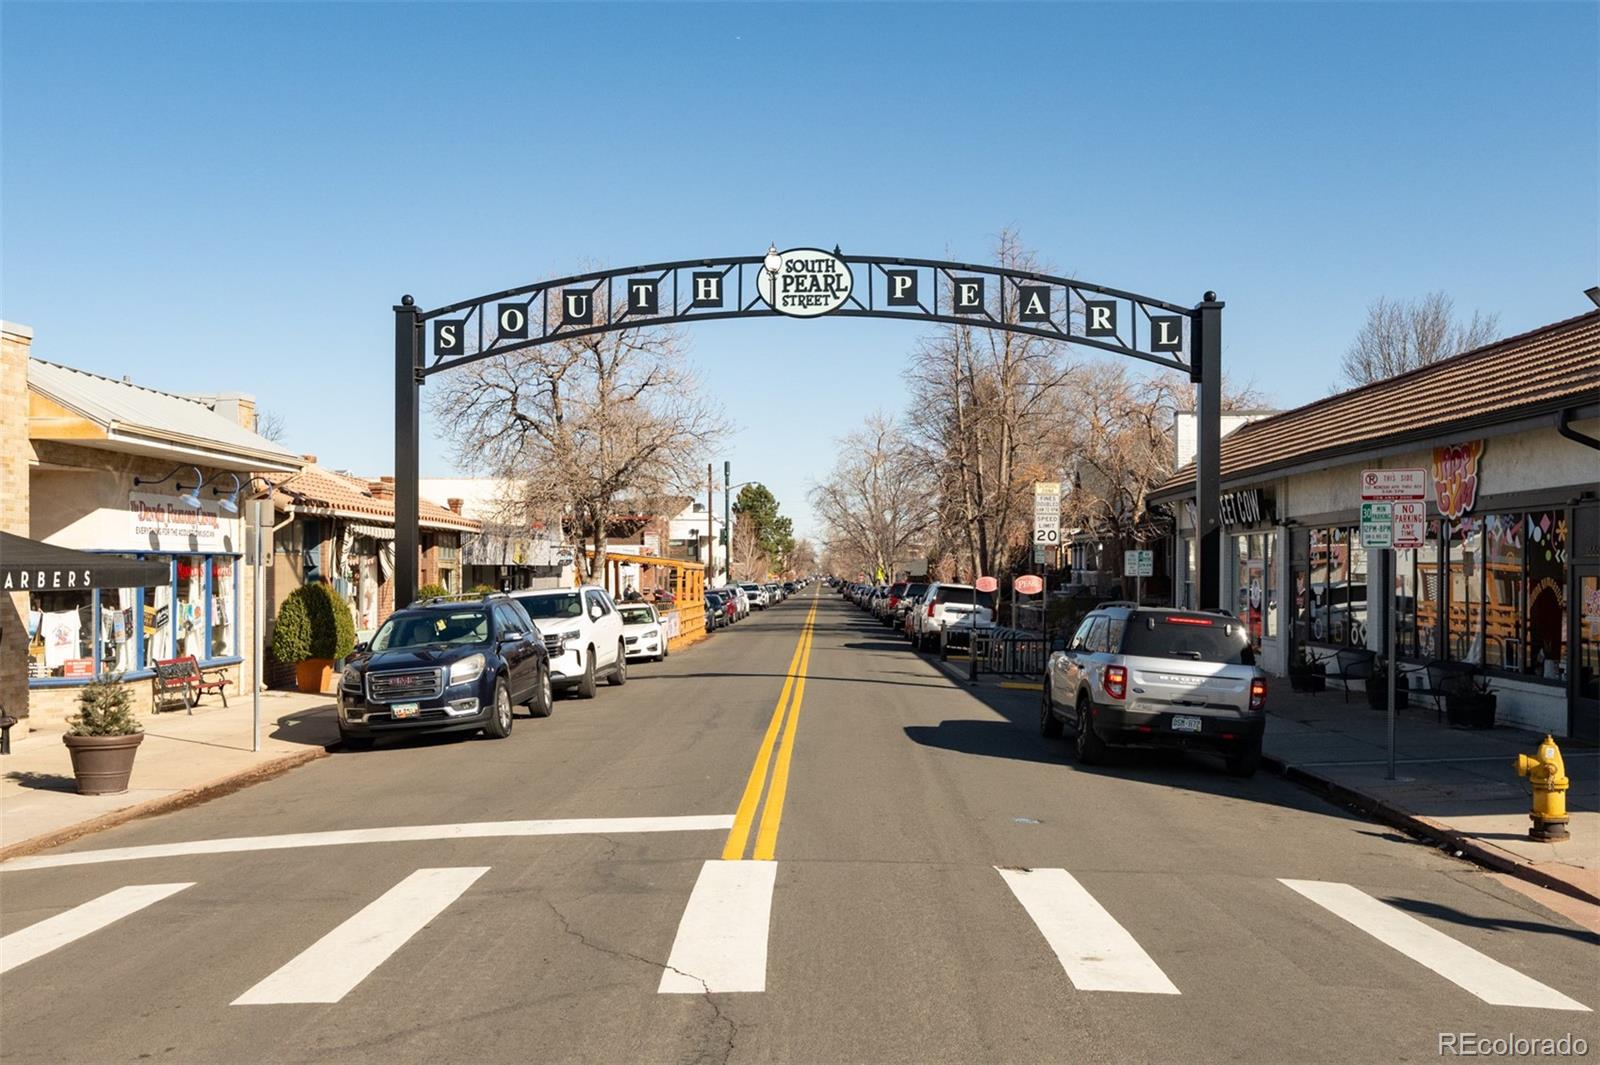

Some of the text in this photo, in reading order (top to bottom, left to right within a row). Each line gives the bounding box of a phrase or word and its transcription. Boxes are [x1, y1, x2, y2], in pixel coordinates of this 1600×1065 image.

[785, 258, 836, 273] SOUTH
[781, 273, 848, 300] PEARL
[782, 294, 831, 309] STREET
[1236, 488, 1261, 523] COW
[1362, 508, 1370, 518] 30
[1402, 504, 1414, 514] NO
[1396, 514, 1422, 523] PARKING
[1037, 530, 1057, 542] 20
[4, 570, 91, 589] ARBERS
